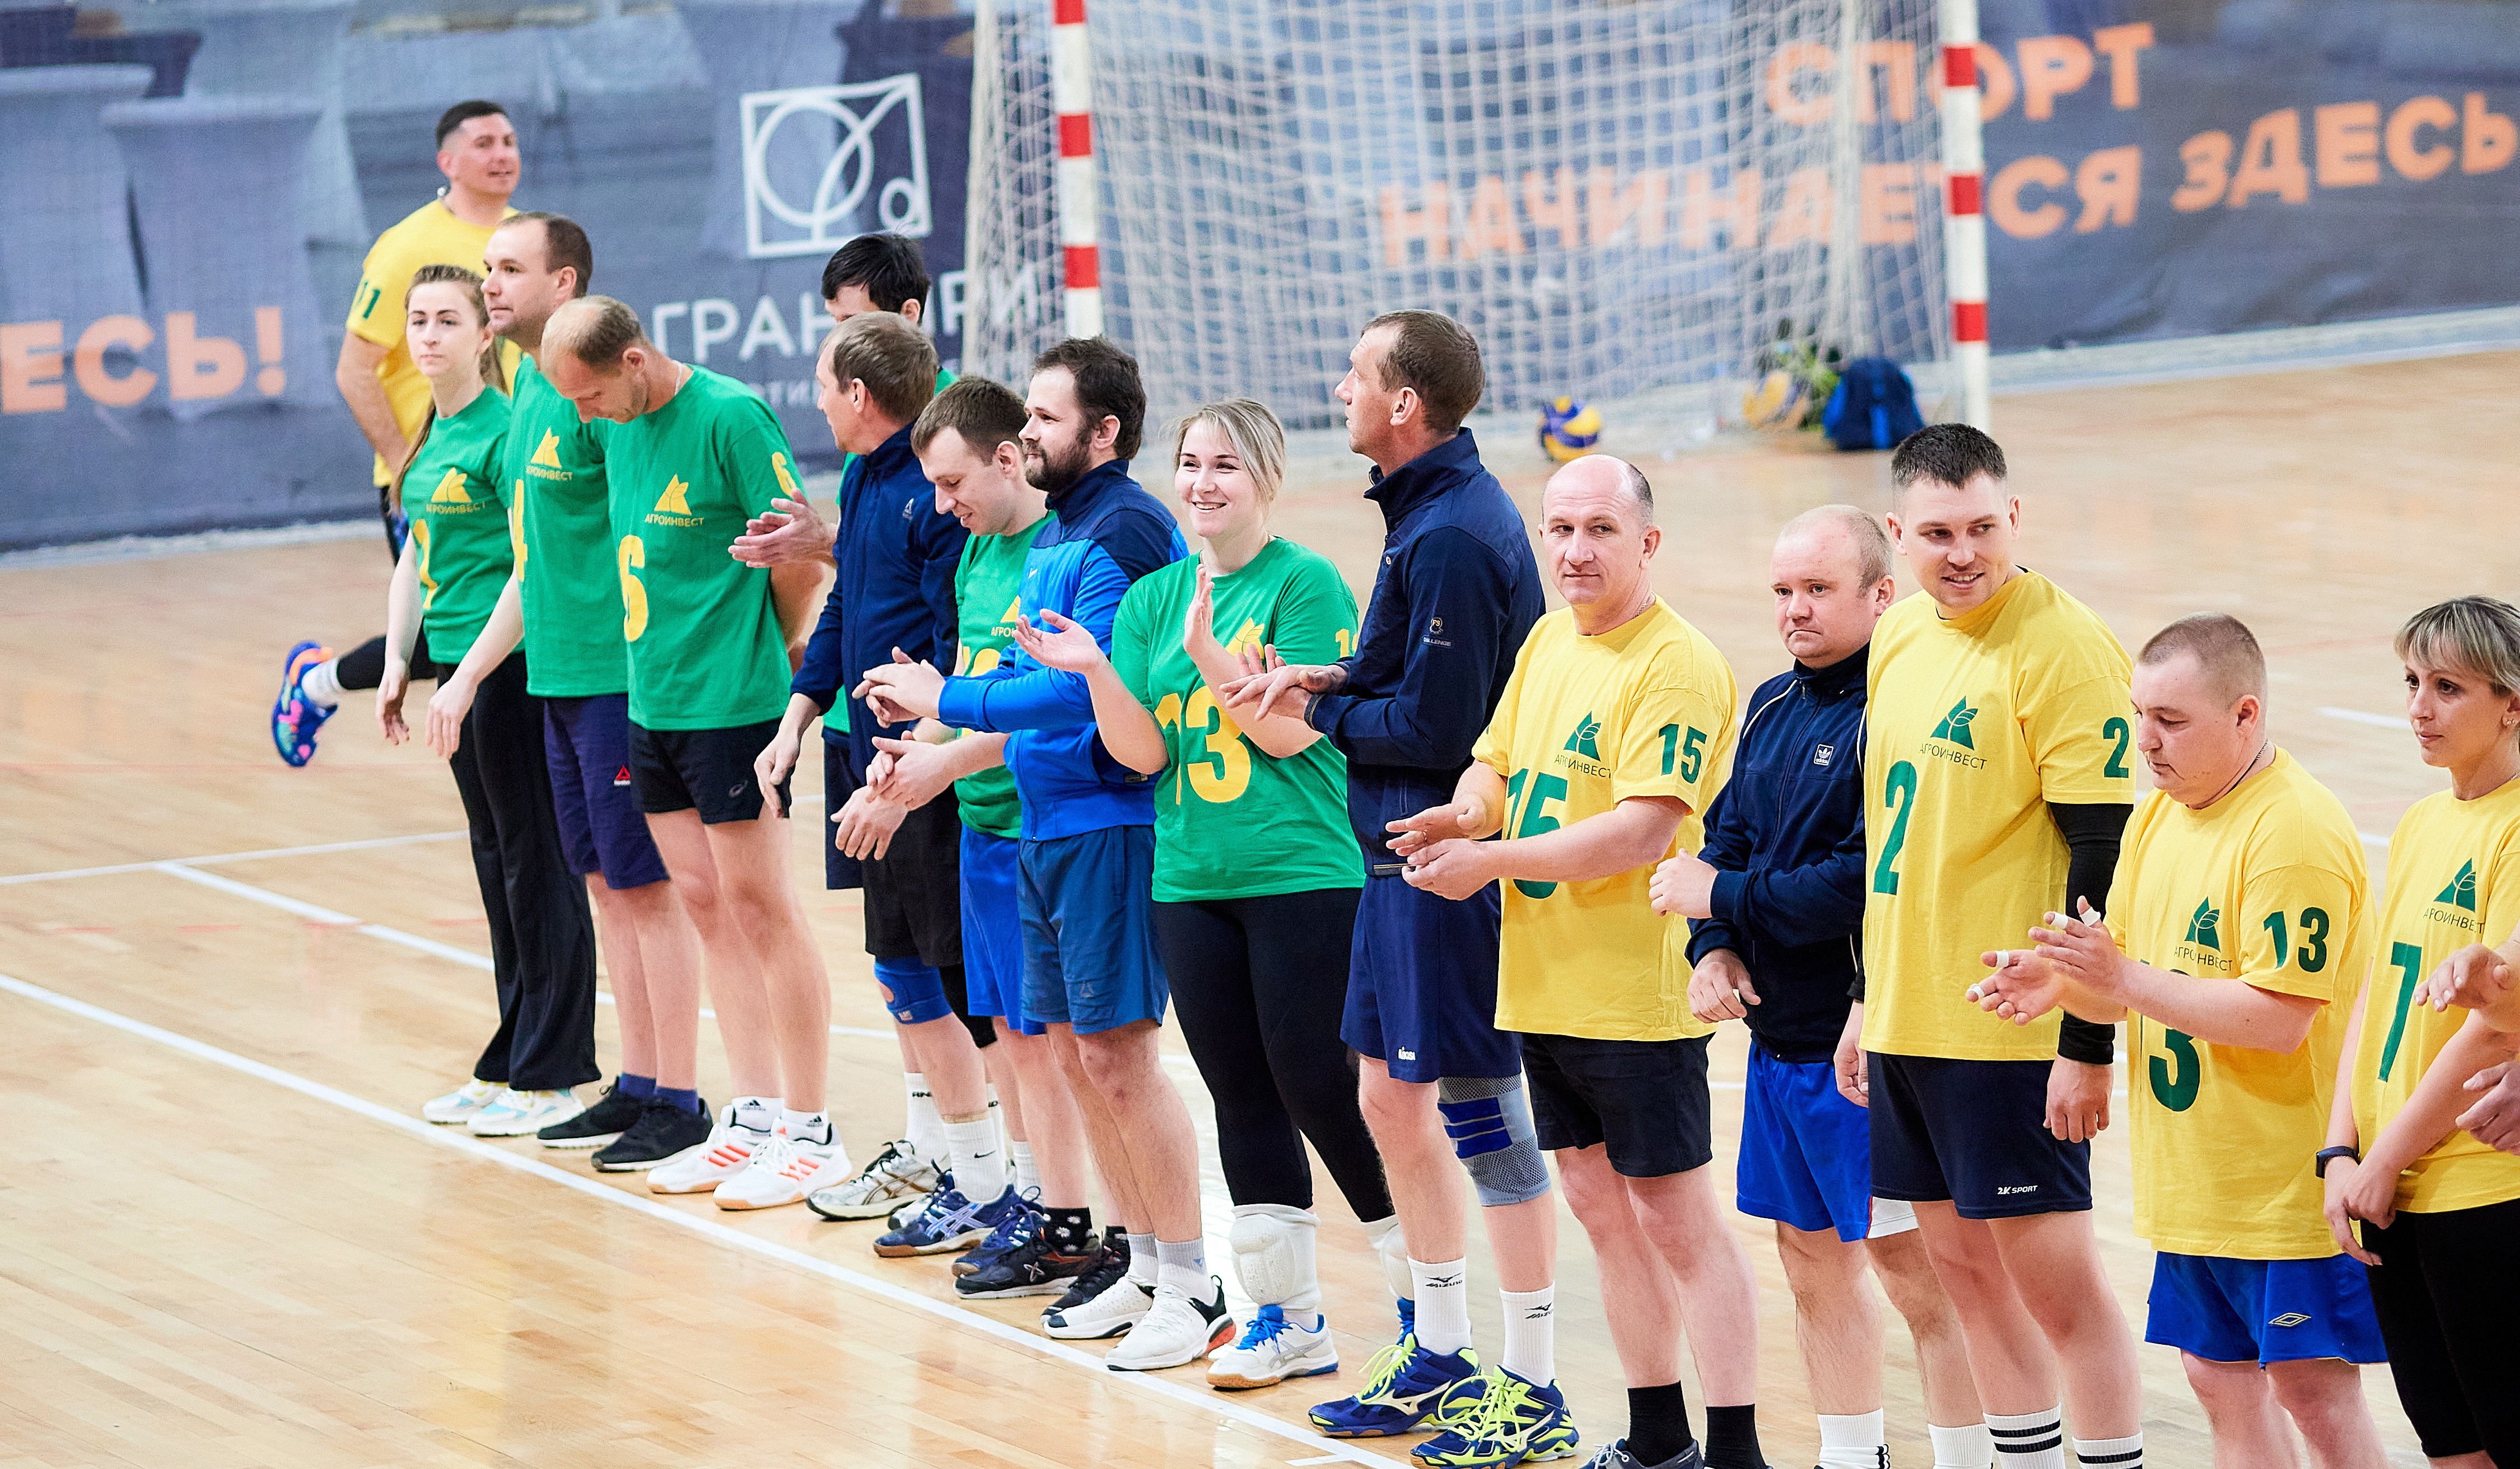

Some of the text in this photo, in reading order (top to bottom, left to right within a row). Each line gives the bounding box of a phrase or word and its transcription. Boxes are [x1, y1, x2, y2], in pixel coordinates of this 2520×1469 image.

[1766, 22, 2155, 127] СПОРТ
[1379, 92, 2519, 266] НАЧИНАЕСЯ ЗДЕСЬ
[772, 452, 797, 498] 6
[645, 513, 704, 527] АГРОИНВЕСТ
[618, 535, 648, 642] 6
[1335, 629, 1357, 658] 1
[1658, 723, 1707, 784] 15
[1919, 743, 1987, 770] АГРОИНВЕСТ
[2103, 717, 2130, 778] 2
[1506, 768, 1568, 899] 15
[1873, 760, 1917, 896] 2
[2263, 907, 2330, 973] 13
[2423, 908, 2485, 934] АРОИНВЕТ
[2173, 947, 2233, 971] АГРОНВЕСТ
[2378, 941, 2423, 1083] 7
[2012, 1185, 2038, 1194] SPORT
